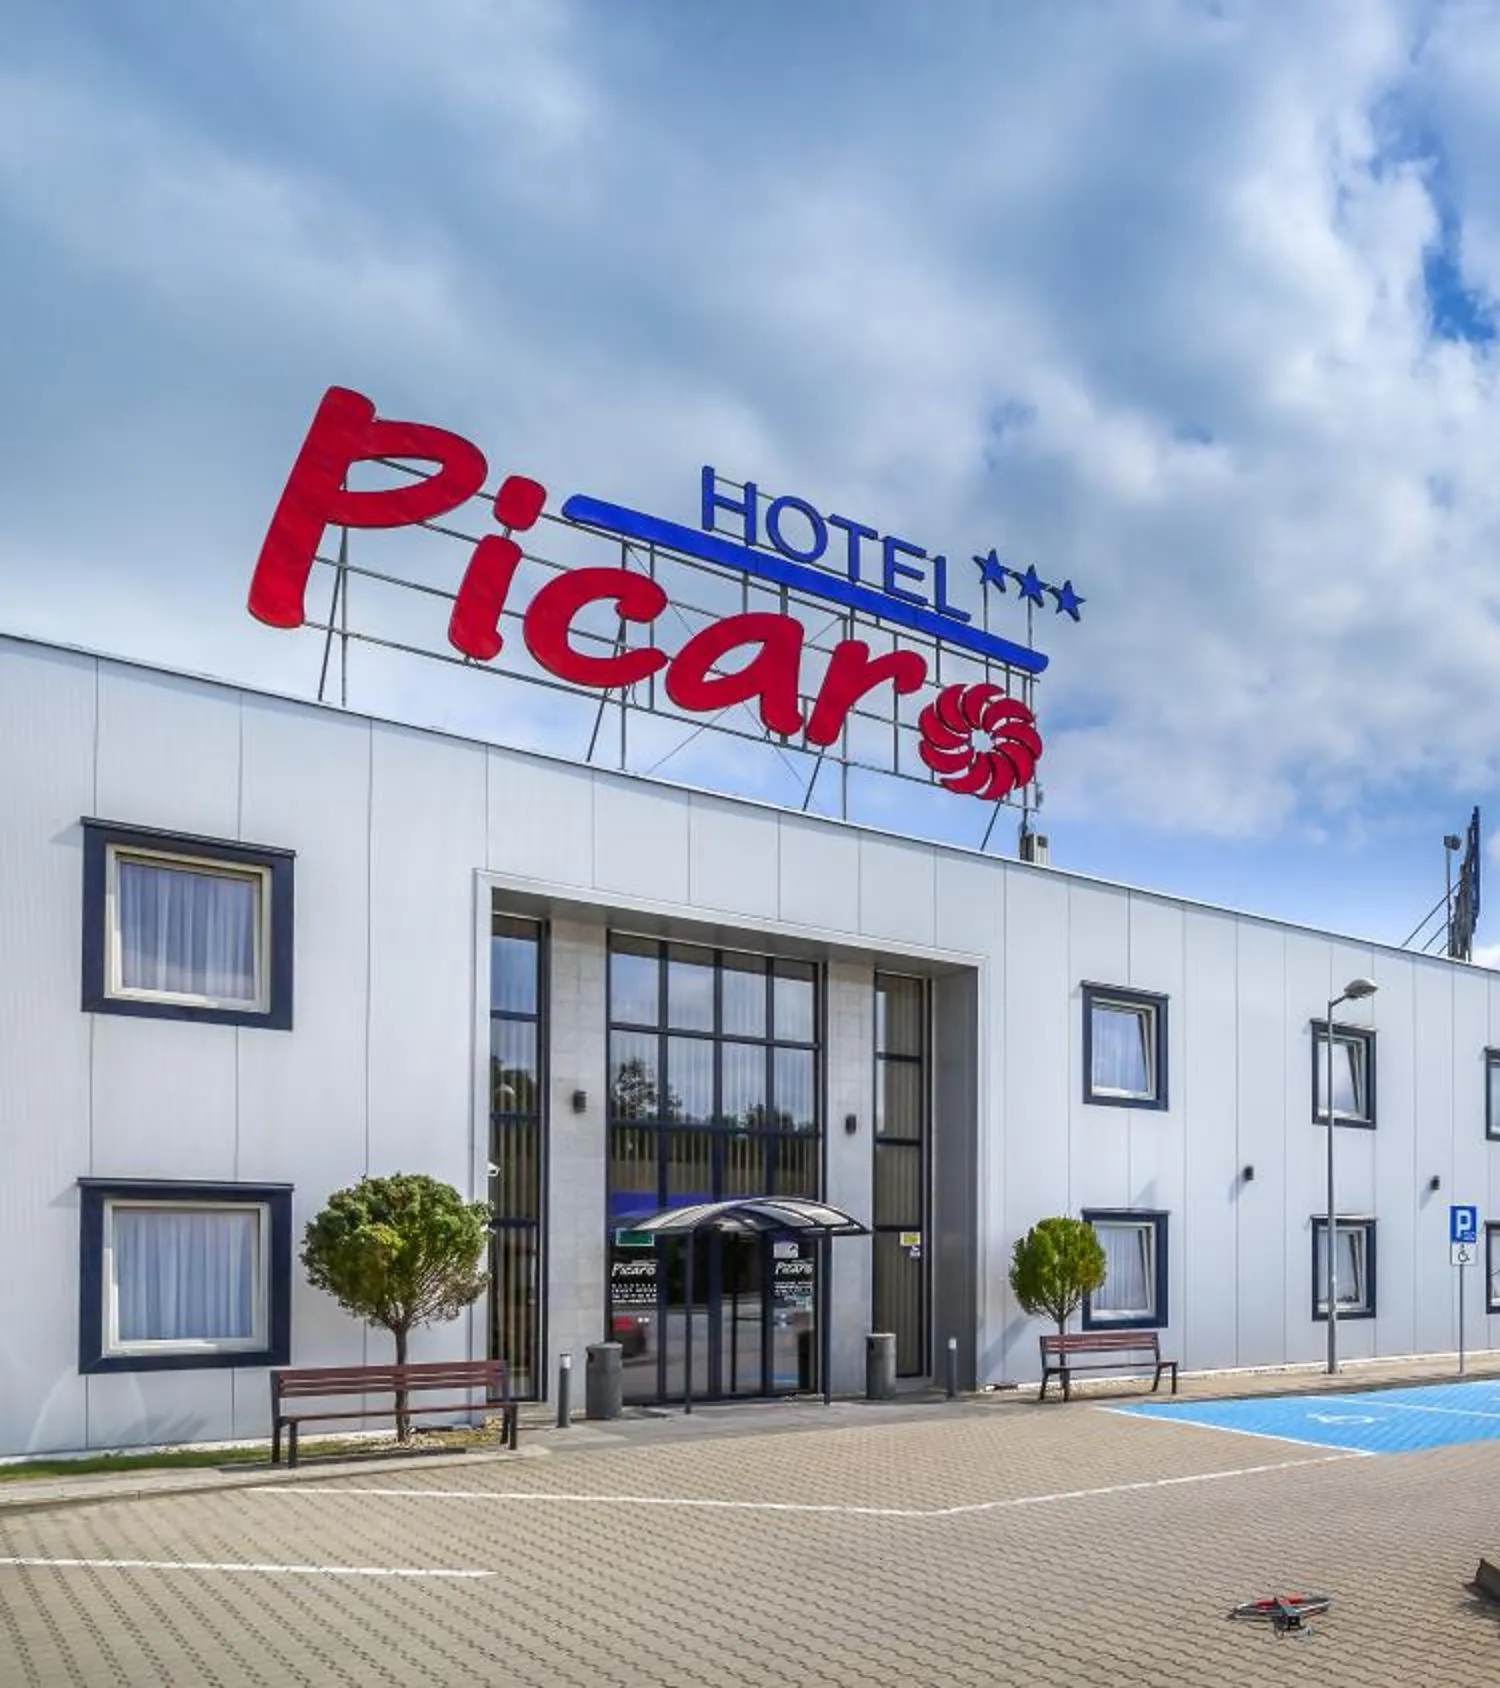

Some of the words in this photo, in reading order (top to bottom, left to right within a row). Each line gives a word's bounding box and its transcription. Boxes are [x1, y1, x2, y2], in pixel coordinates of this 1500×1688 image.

[248, 386, 1043, 801] Picaro
[702, 466, 972, 622] HOTEL
[1456, 1209, 1472, 1239] P
